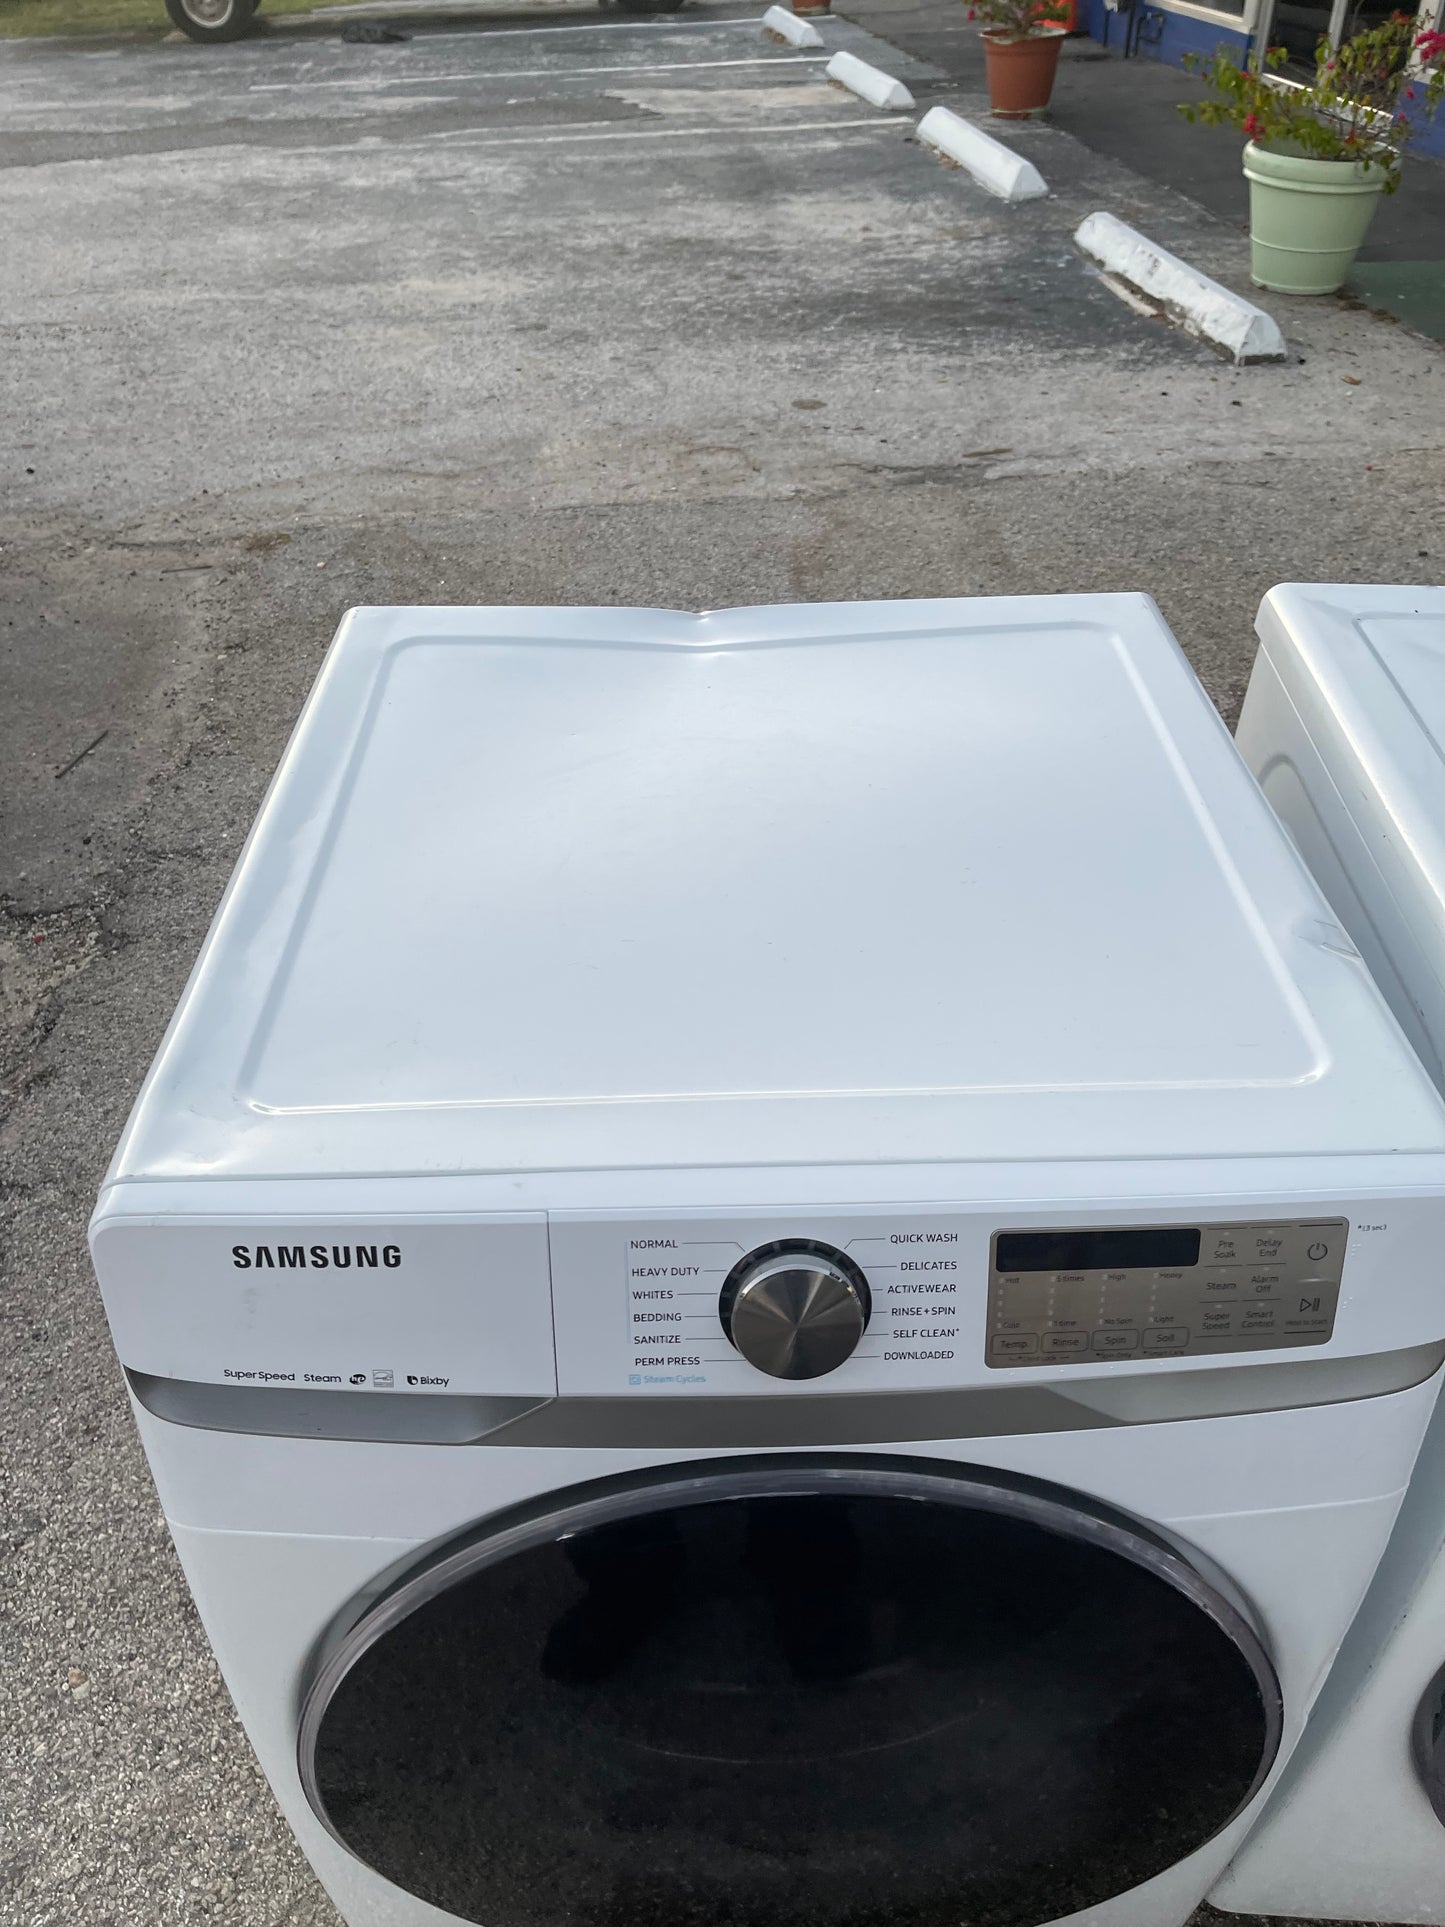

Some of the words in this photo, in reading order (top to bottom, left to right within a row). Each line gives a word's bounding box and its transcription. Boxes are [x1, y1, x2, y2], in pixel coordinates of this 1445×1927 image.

[890, 1234, 924, 1244] QUICK
[926, 1233, 958, 1242] WASH
[630, 1240, 678, 1249] NORMAL
[1256, 1239, 1283, 1248] Delay
[1214, 1250, 1236, 1258] Soak
[1260, 1248, 1278, 1256] End
[232, 1245, 402, 1269] SAMSUNG
[900, 1261, 958, 1271] DELICATES
[632, 1268, 668, 1277] HEAVY
[671, 1267, 700, 1276] DUTY
[887, 1284, 956, 1294] ACTIVEWEAR
[1206, 1282, 1236, 1290] Steam
[632, 1290, 674, 1300] WHITES
[633, 1313, 682, 1322] BEDDING
[1204, 1314, 1230, 1322] Super
[1246, 1310, 1274, 1318] Smart
[1202, 1322, 1230, 1330] Speed
[1242, 1320, 1274, 1328] Control
[892, 1330, 918, 1338] SELF
[1156, 1334, 1176, 1342] Soil
[634, 1335, 681, 1344] SANITIZE
[1104, 1336, 1127, 1346] Spin
[884, 1350, 954, 1360] DOWNLOADED
[634, 1357, 664, 1366] PERM
[667, 1356, 700, 1366] PRESS
[304, 1372, 342, 1384] Steam
[420, 1374, 450, 1388] Bixby
[644, 1375, 673, 1384] Steam
[676, 1375, 706, 1385] Cycles
